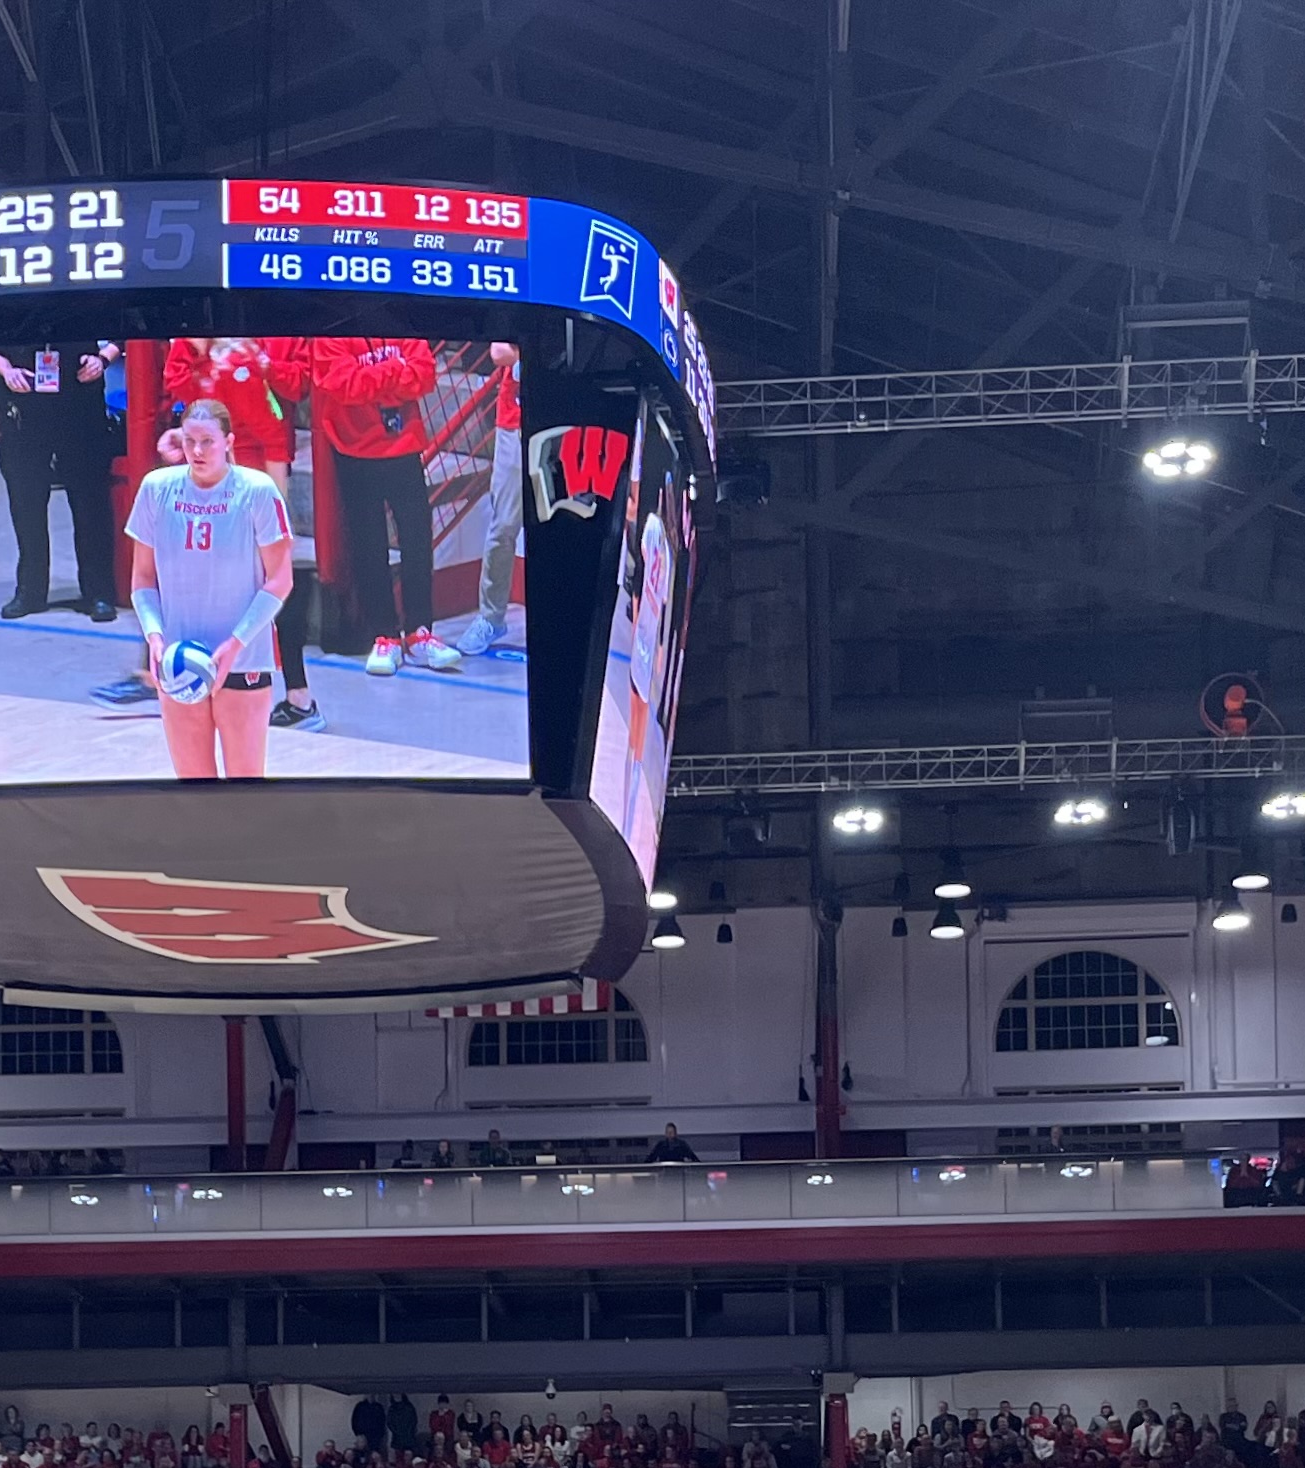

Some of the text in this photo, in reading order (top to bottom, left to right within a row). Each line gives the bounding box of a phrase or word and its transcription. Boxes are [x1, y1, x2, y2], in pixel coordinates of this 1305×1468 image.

[69, 189, 124, 228] 21
[259, 187, 521, 229] 54 .311 12 135
[255, 228, 299, 244] KILLS
[414, 234, 445, 250] ERR
[474, 238, 503, 254] ATT
[0, 246, 52, 285] 12
[68, 242, 124, 280] 12
[260, 254, 520, 294] 46 .086 33 151
[184, 521, 212, 551] 13
